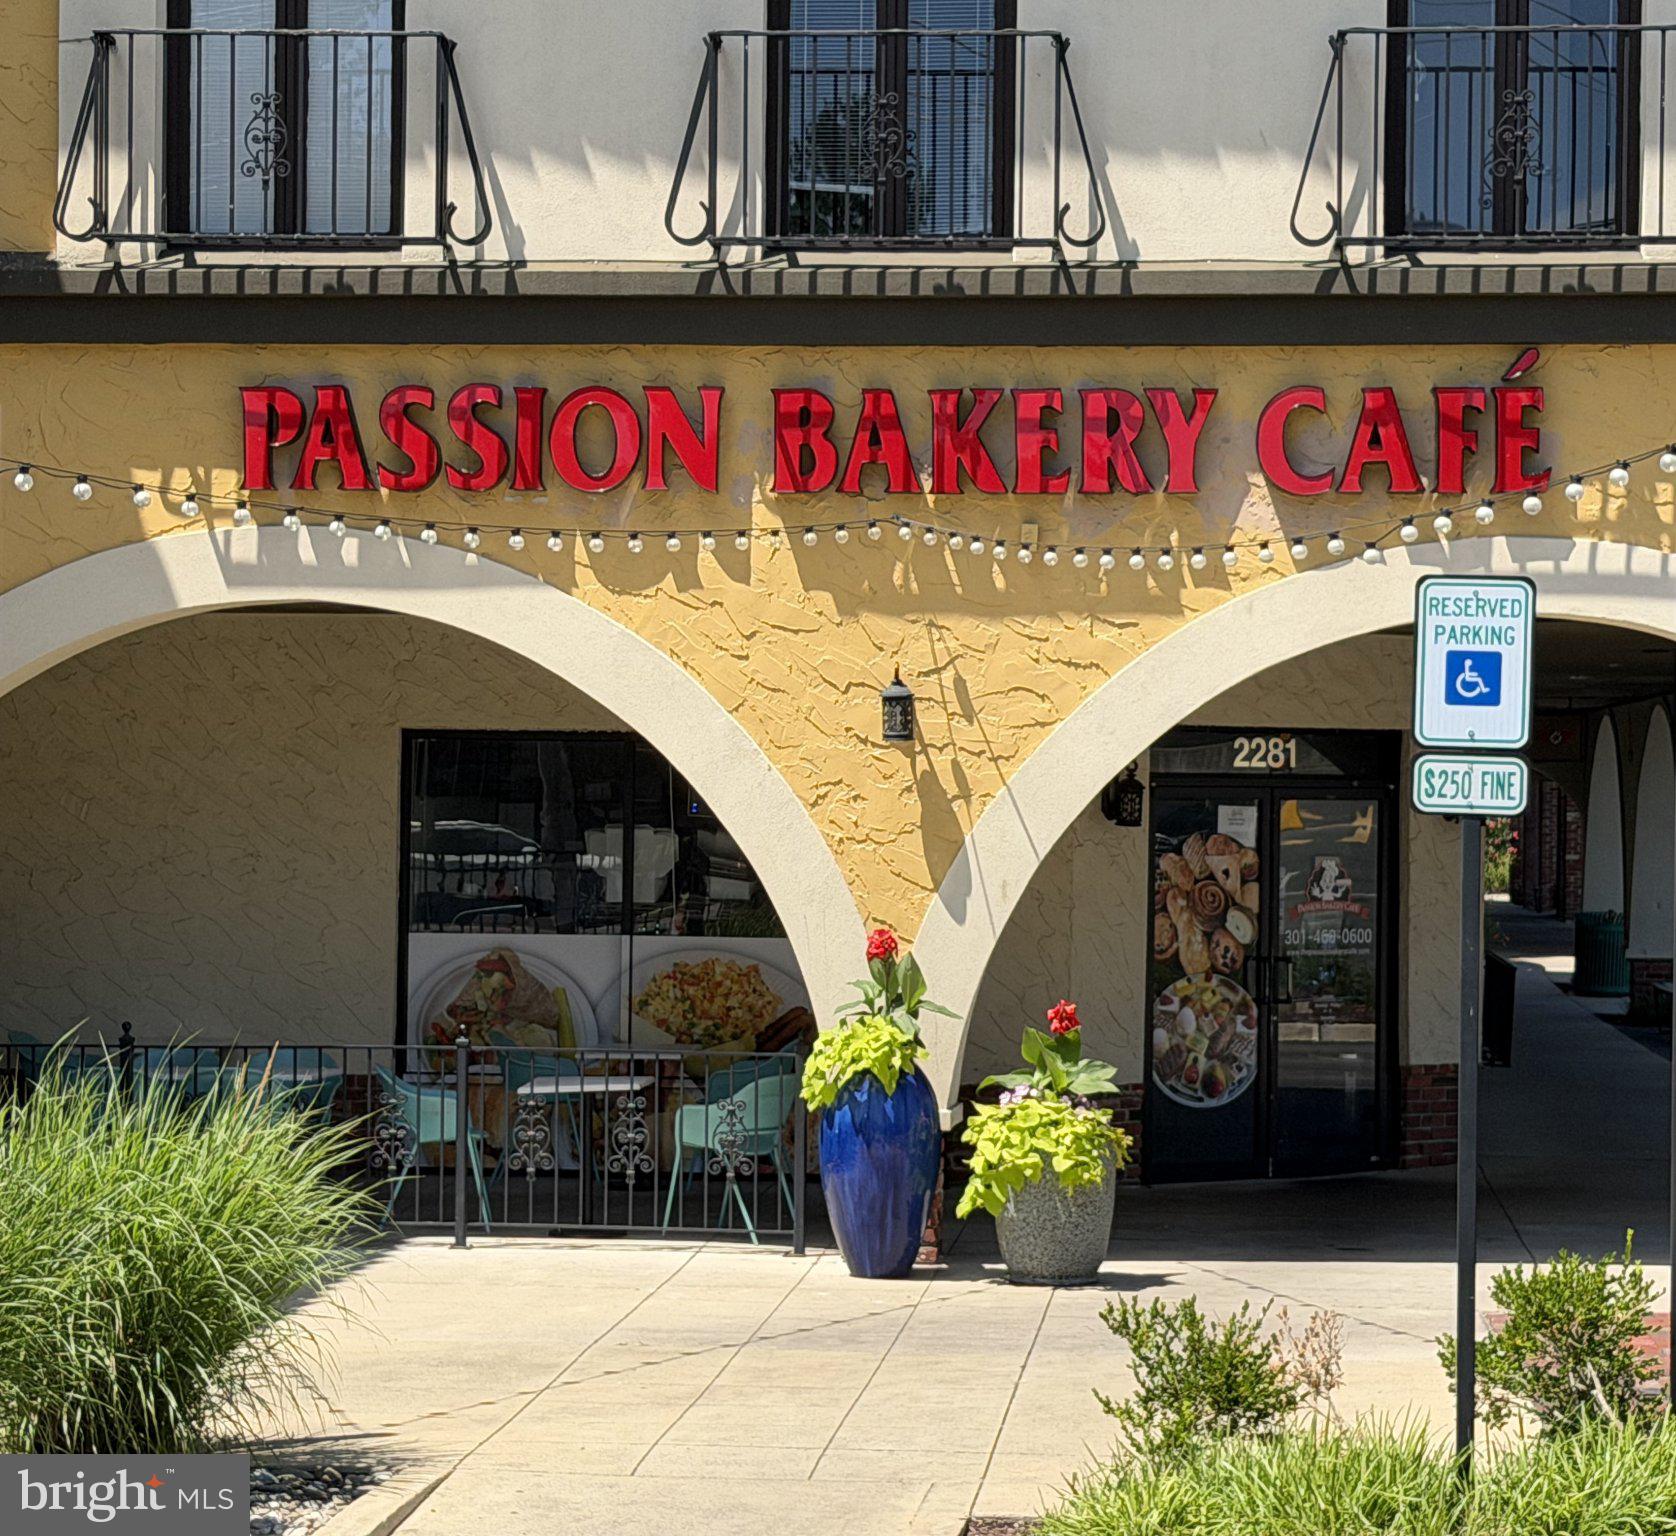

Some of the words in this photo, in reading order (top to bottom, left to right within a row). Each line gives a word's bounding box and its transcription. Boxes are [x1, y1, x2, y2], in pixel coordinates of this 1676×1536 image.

[239, 384, 725, 494] PASSION
[771, 388, 1218, 495] BAKERY
[1256, 348, 1552, 496] CAFÉ
[1429, 597, 1522, 618] RESERVED
[1434, 625, 1516, 646] PARKING
[1233, 736, 1296, 768] 2281
[1424, 768, 1472, 800] $250
[1481, 771, 1517, 800] FINE
